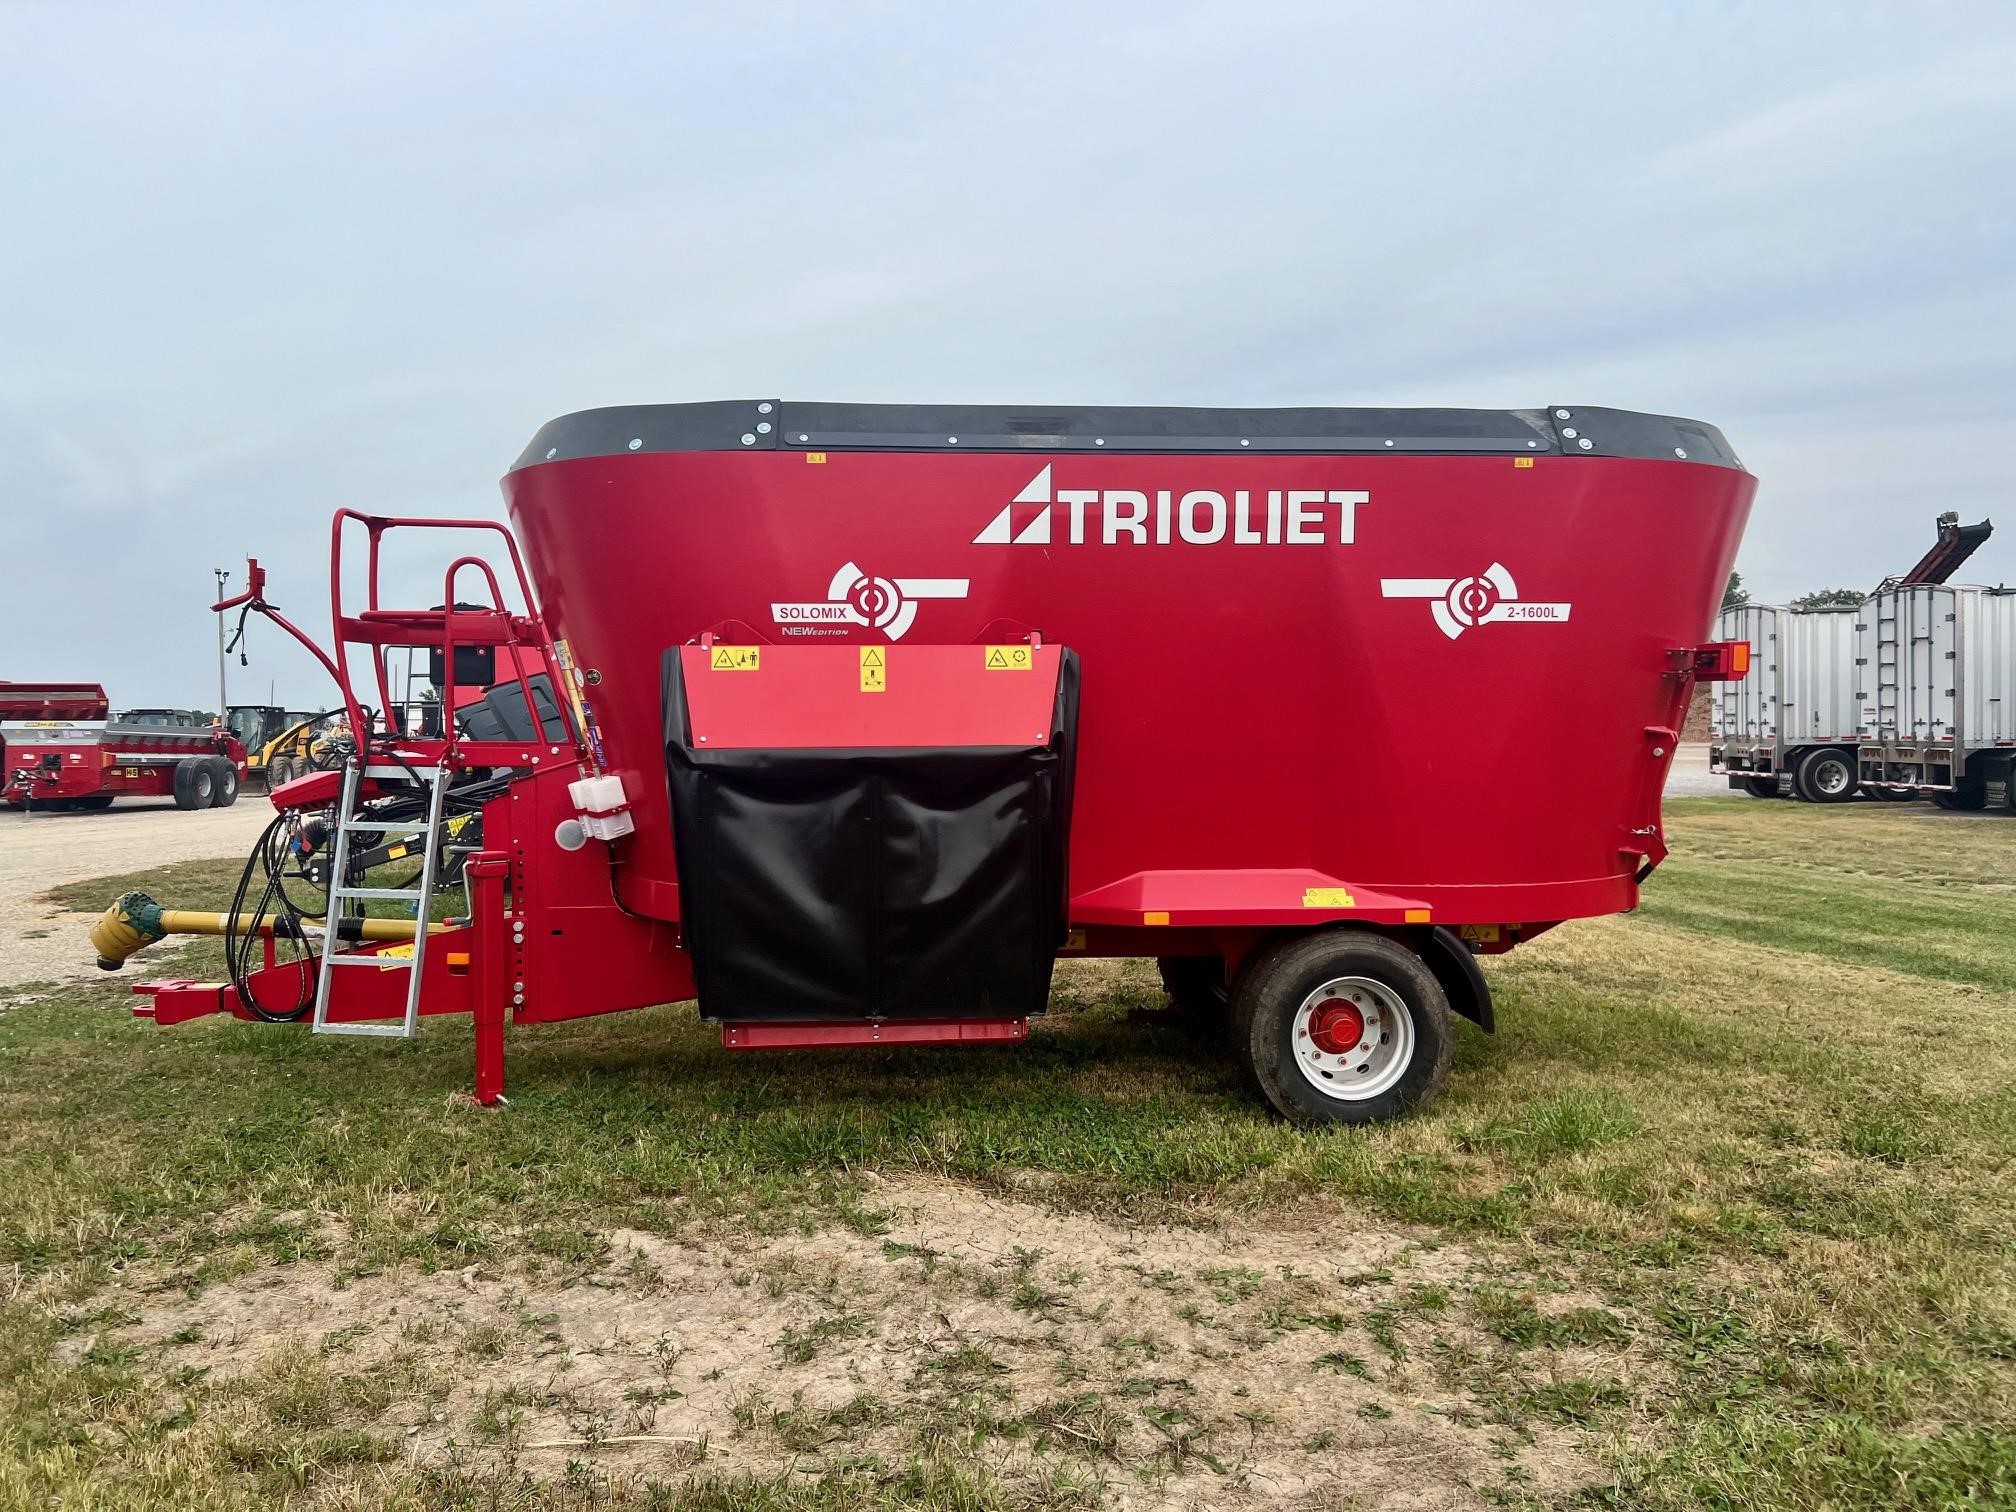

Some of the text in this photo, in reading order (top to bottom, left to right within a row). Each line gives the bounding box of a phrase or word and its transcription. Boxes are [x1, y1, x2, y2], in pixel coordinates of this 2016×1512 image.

[1056, 490, 1370, 545] TRIOLIET
[779, 607, 847, 619] SOLOMIX
[1507, 606, 1559, 618] 2-1600L
